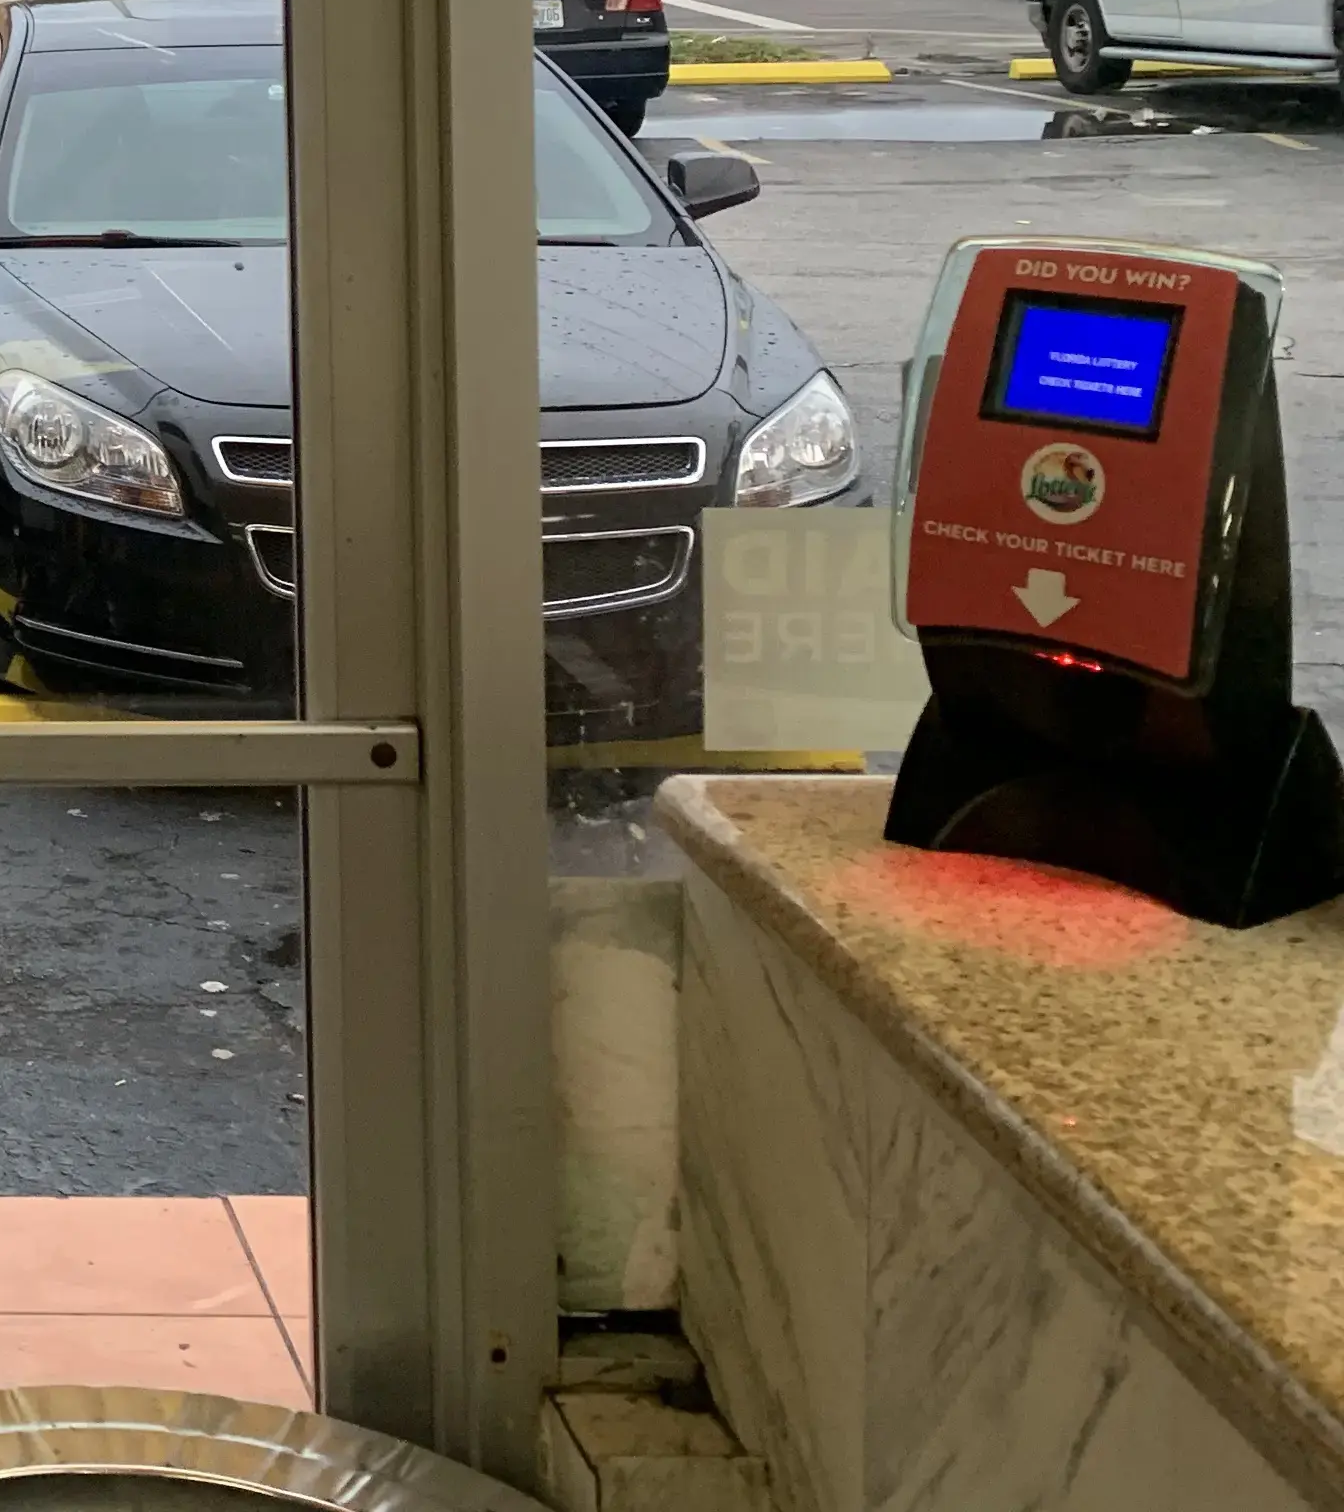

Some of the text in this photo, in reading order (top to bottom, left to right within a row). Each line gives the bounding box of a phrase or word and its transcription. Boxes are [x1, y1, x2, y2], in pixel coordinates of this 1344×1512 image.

[1016, 259, 1192, 291] DID YOU WIN?
[923, 520, 1187, 579] CHECK YOUR TICKET HERE
